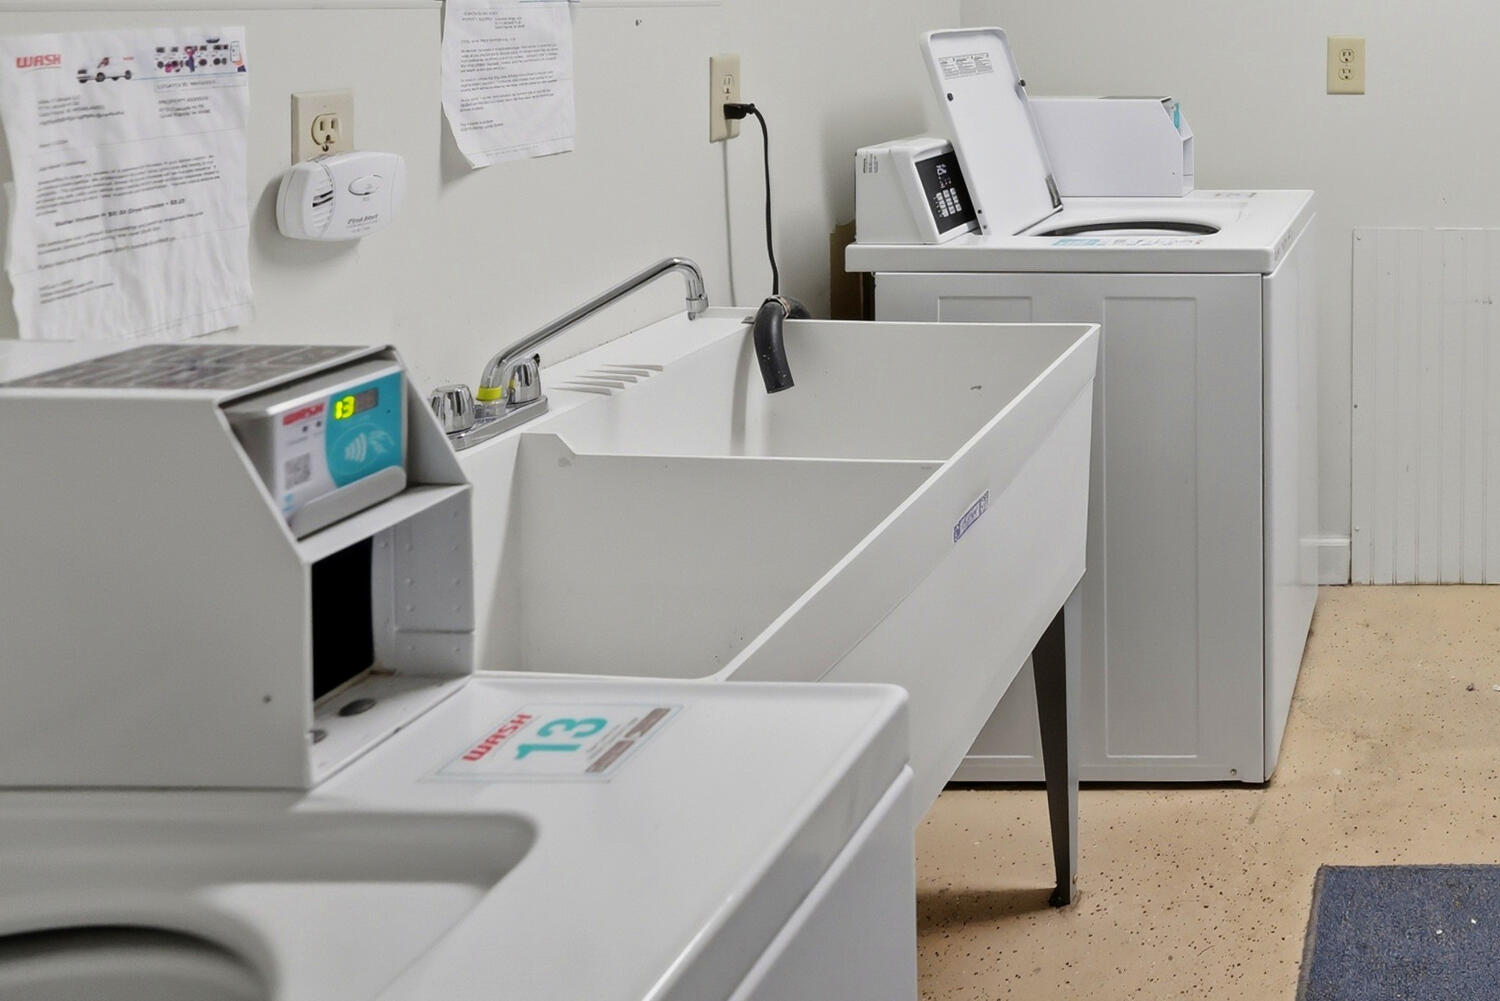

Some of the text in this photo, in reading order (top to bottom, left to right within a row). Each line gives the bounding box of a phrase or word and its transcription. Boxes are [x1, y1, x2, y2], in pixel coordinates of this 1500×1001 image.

[16, 54, 62, 69] WASH
[334, 395, 356, 421] 13
[462, 713, 534, 762] WASH
[513, 716, 608, 761] 13
